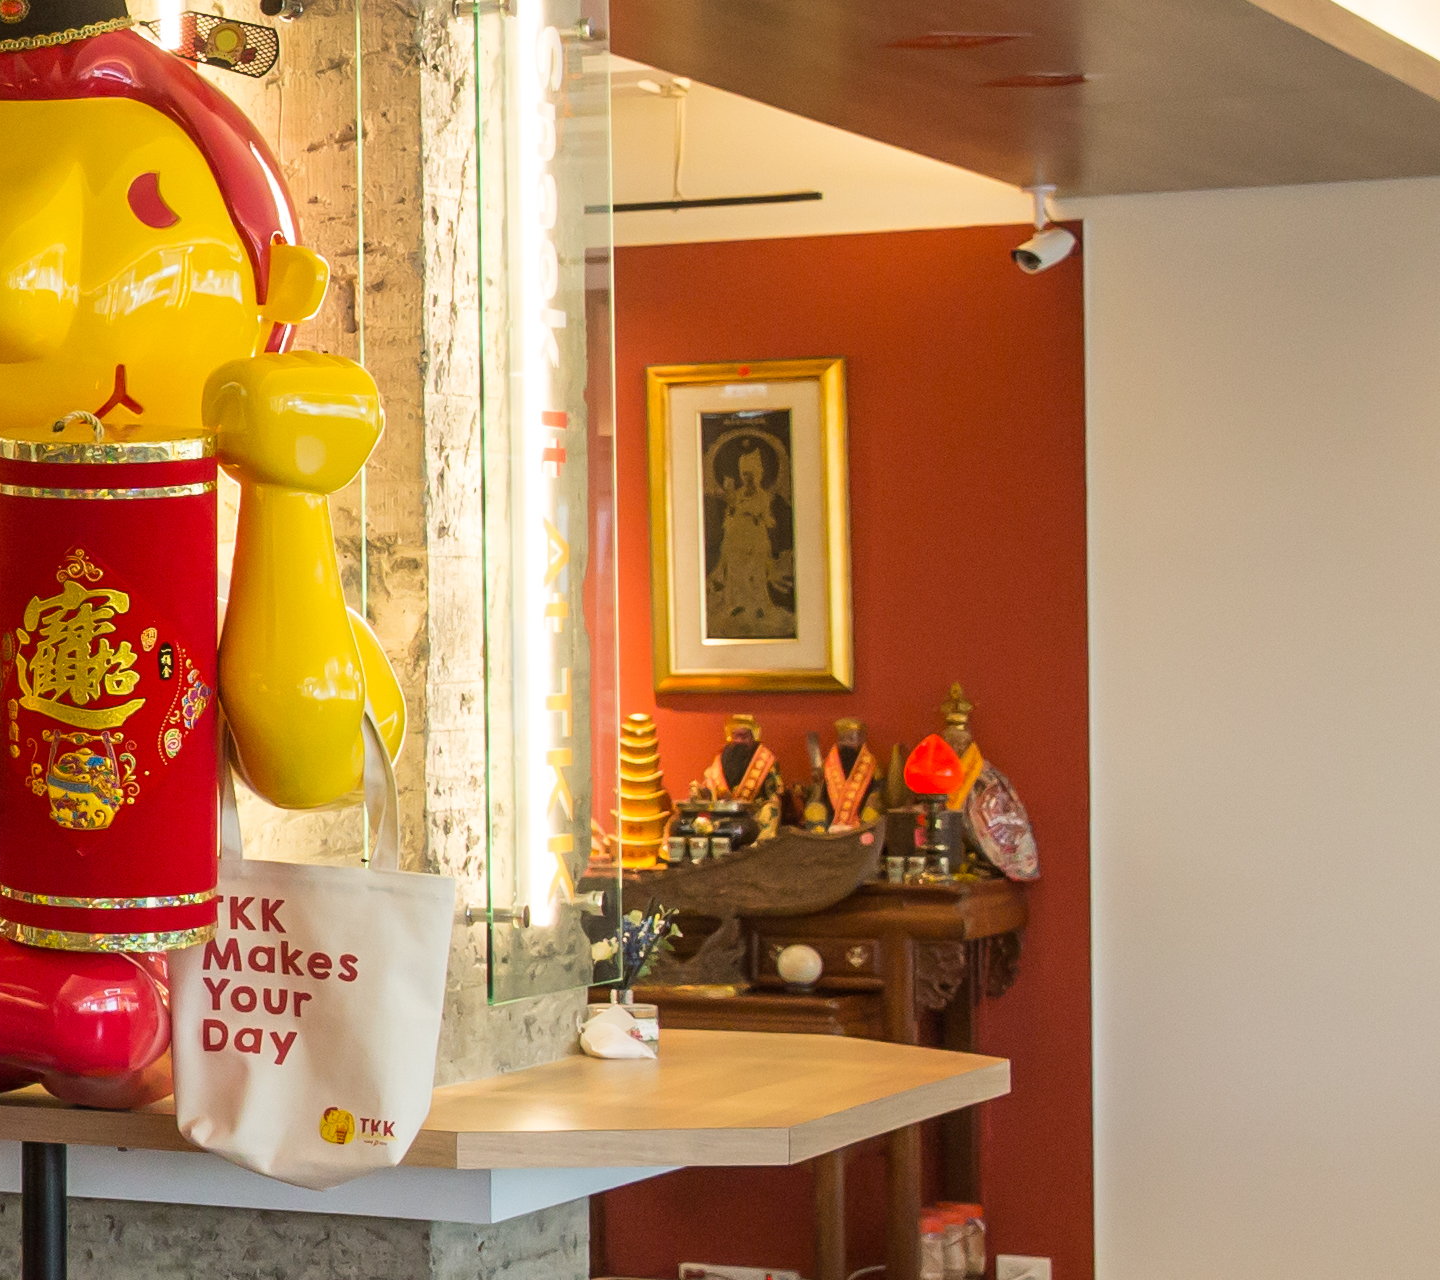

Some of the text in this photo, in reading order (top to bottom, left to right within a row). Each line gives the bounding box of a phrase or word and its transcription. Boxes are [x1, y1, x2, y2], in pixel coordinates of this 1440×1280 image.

[543, 516, 570, 633] At
[545, 668, 575, 904] TKK
[203, 939, 360, 983] Makes
[203, 978, 313, 1019] Your
[203, 1019, 298, 1065] Day
[359, 1117, 396, 1138] TKK
